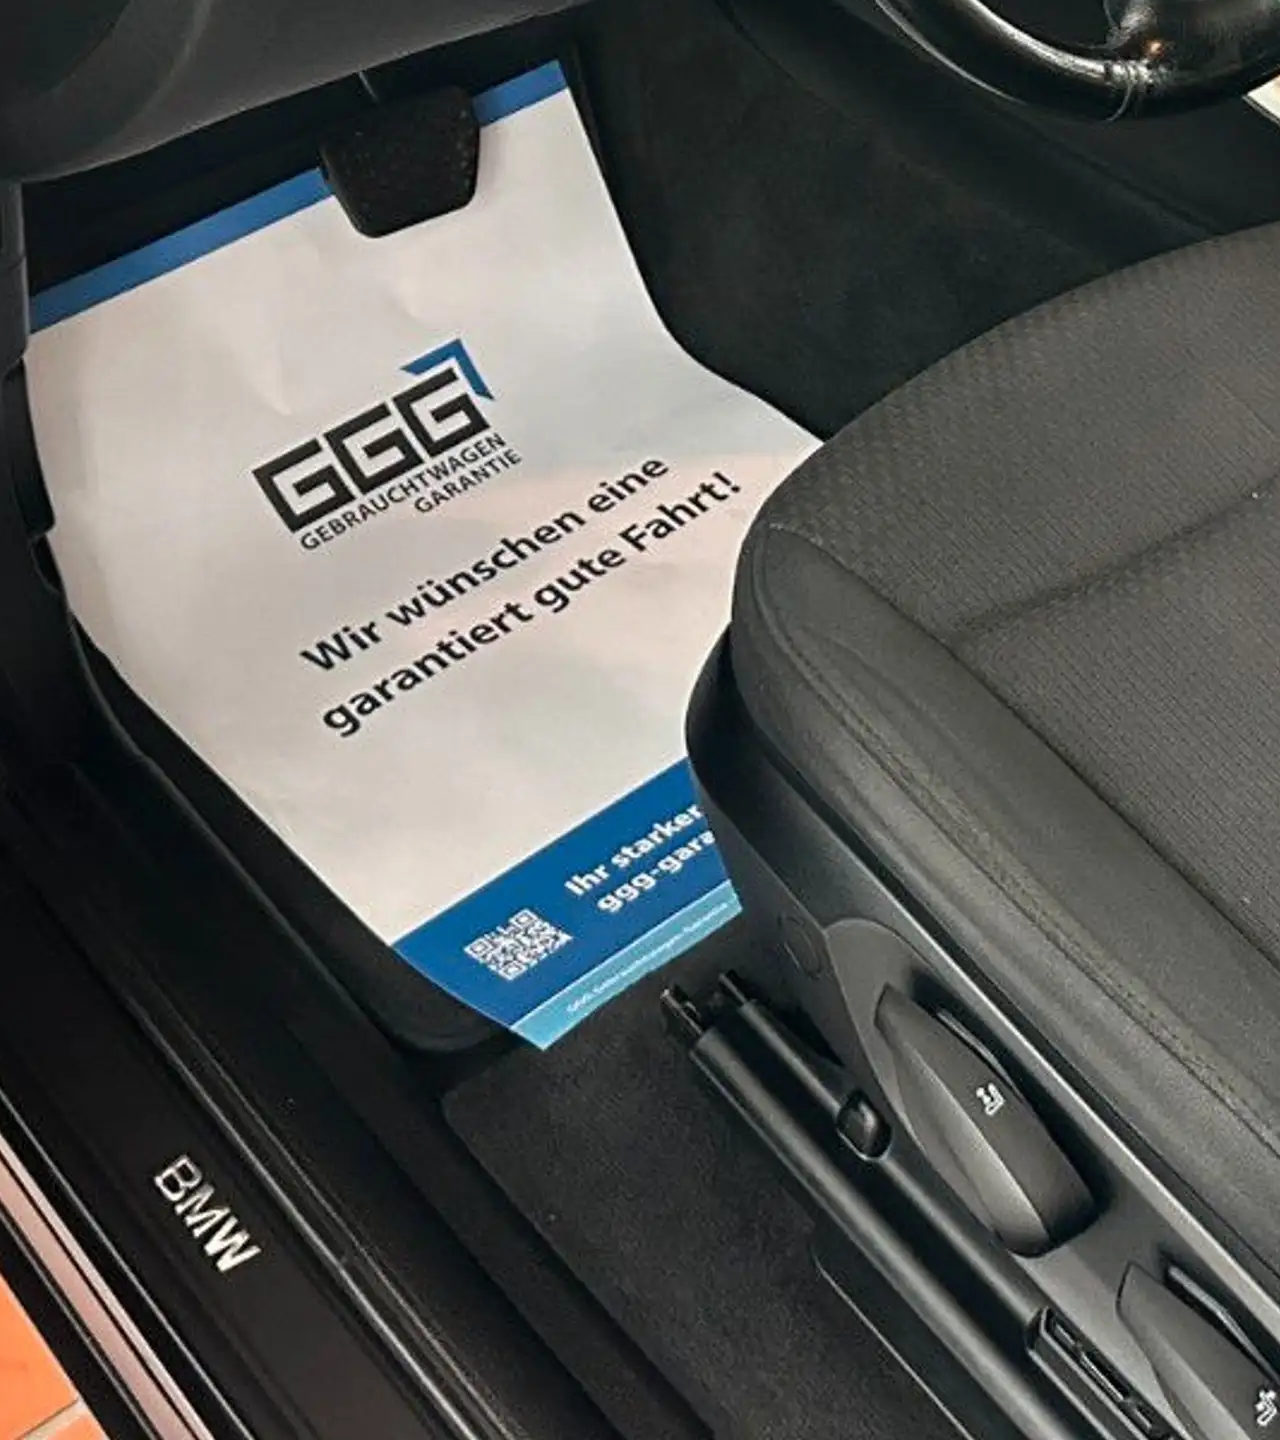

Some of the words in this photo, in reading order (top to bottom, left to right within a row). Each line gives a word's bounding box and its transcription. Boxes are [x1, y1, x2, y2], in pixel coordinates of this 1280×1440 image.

[252, 366, 491, 533] GGG
[299, 433, 507, 552] GEBRAUCHTWAGEN
[413, 447, 522, 514] GARANTIE
[299, 617, 384, 673] Wir
[386, 516, 584, 628] wünschen
[586, 455, 669, 515] eine
[321, 601, 535, 738] garantiert
[534, 547, 627, 613] gute
[615, 471, 742, 556] Fahrt!
[563, 863, 611, 898] Ihr
[610, 802, 704, 869] starker
[153, 1154, 263, 1273] BMW
